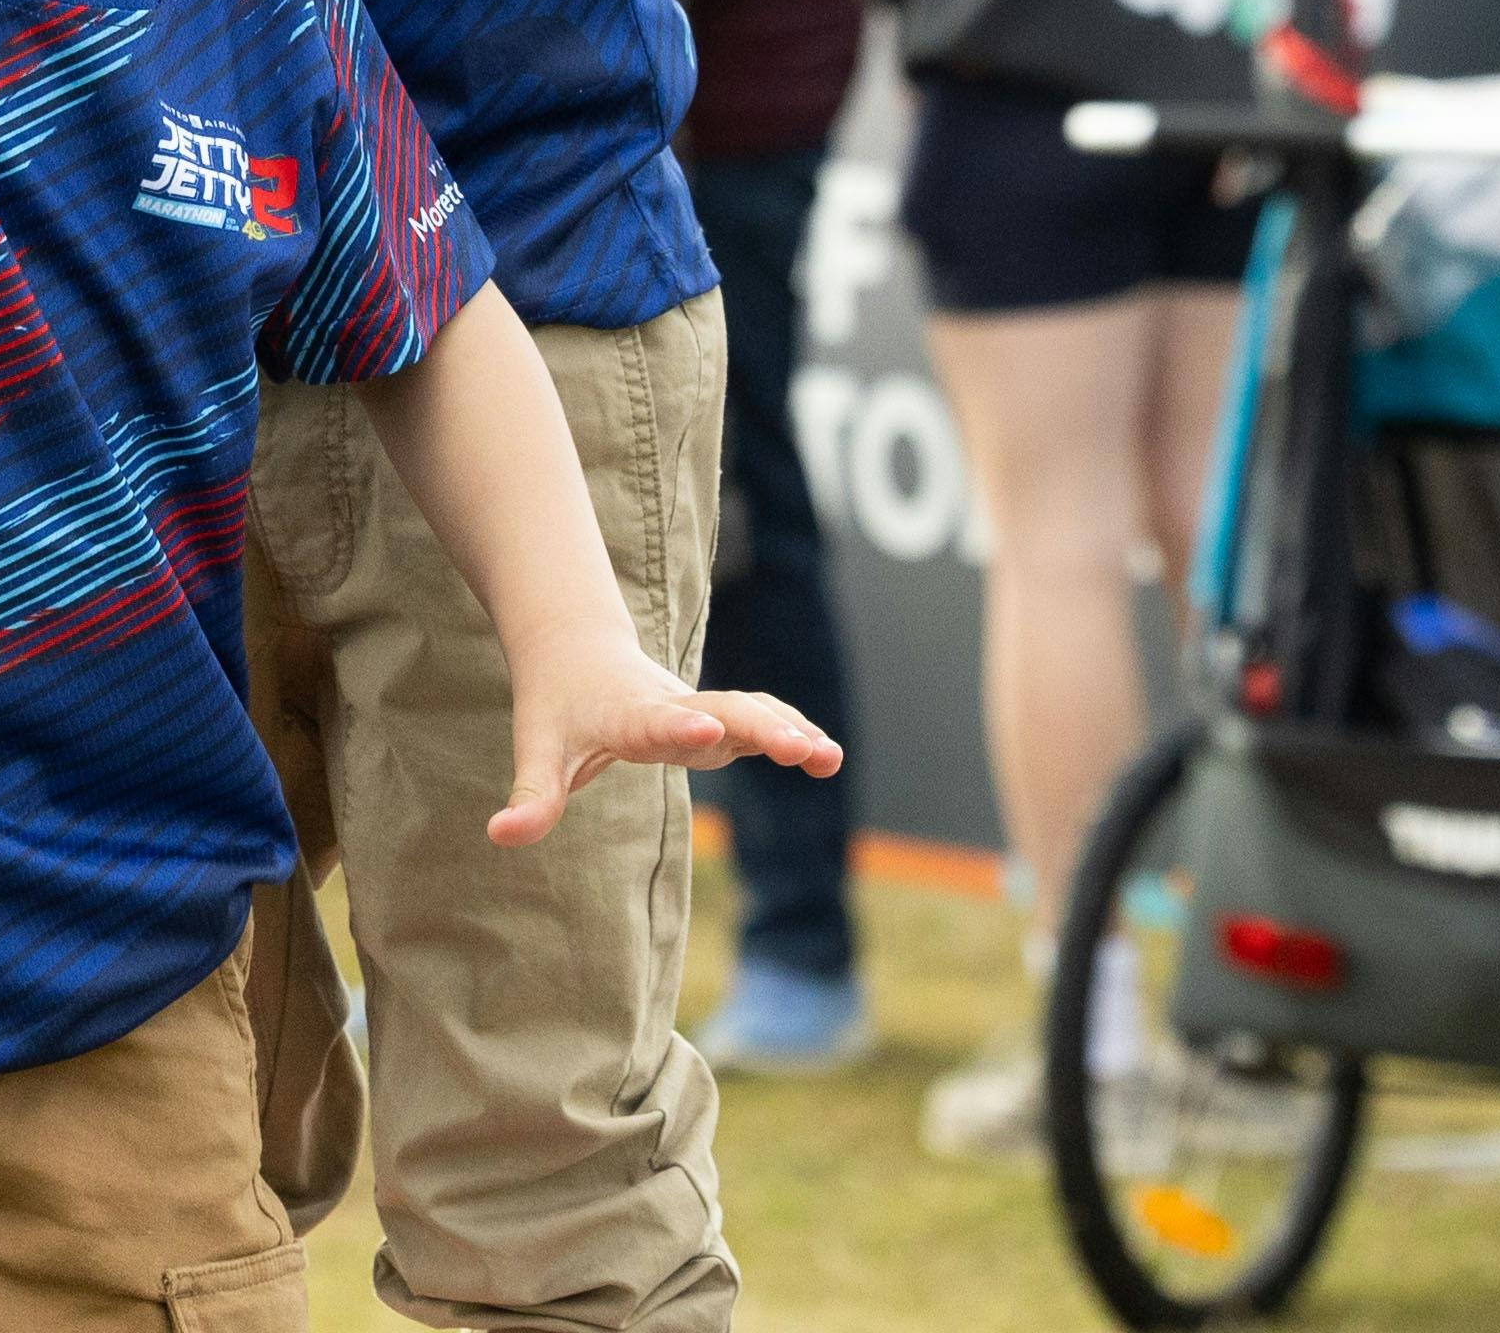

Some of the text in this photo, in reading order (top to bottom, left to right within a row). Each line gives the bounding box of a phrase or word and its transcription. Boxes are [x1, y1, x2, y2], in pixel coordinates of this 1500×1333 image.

[158, 116, 250, 181] JETTY
[136, 196, 225, 227] MARATHON
[139, 154, 252, 216] JETTY
